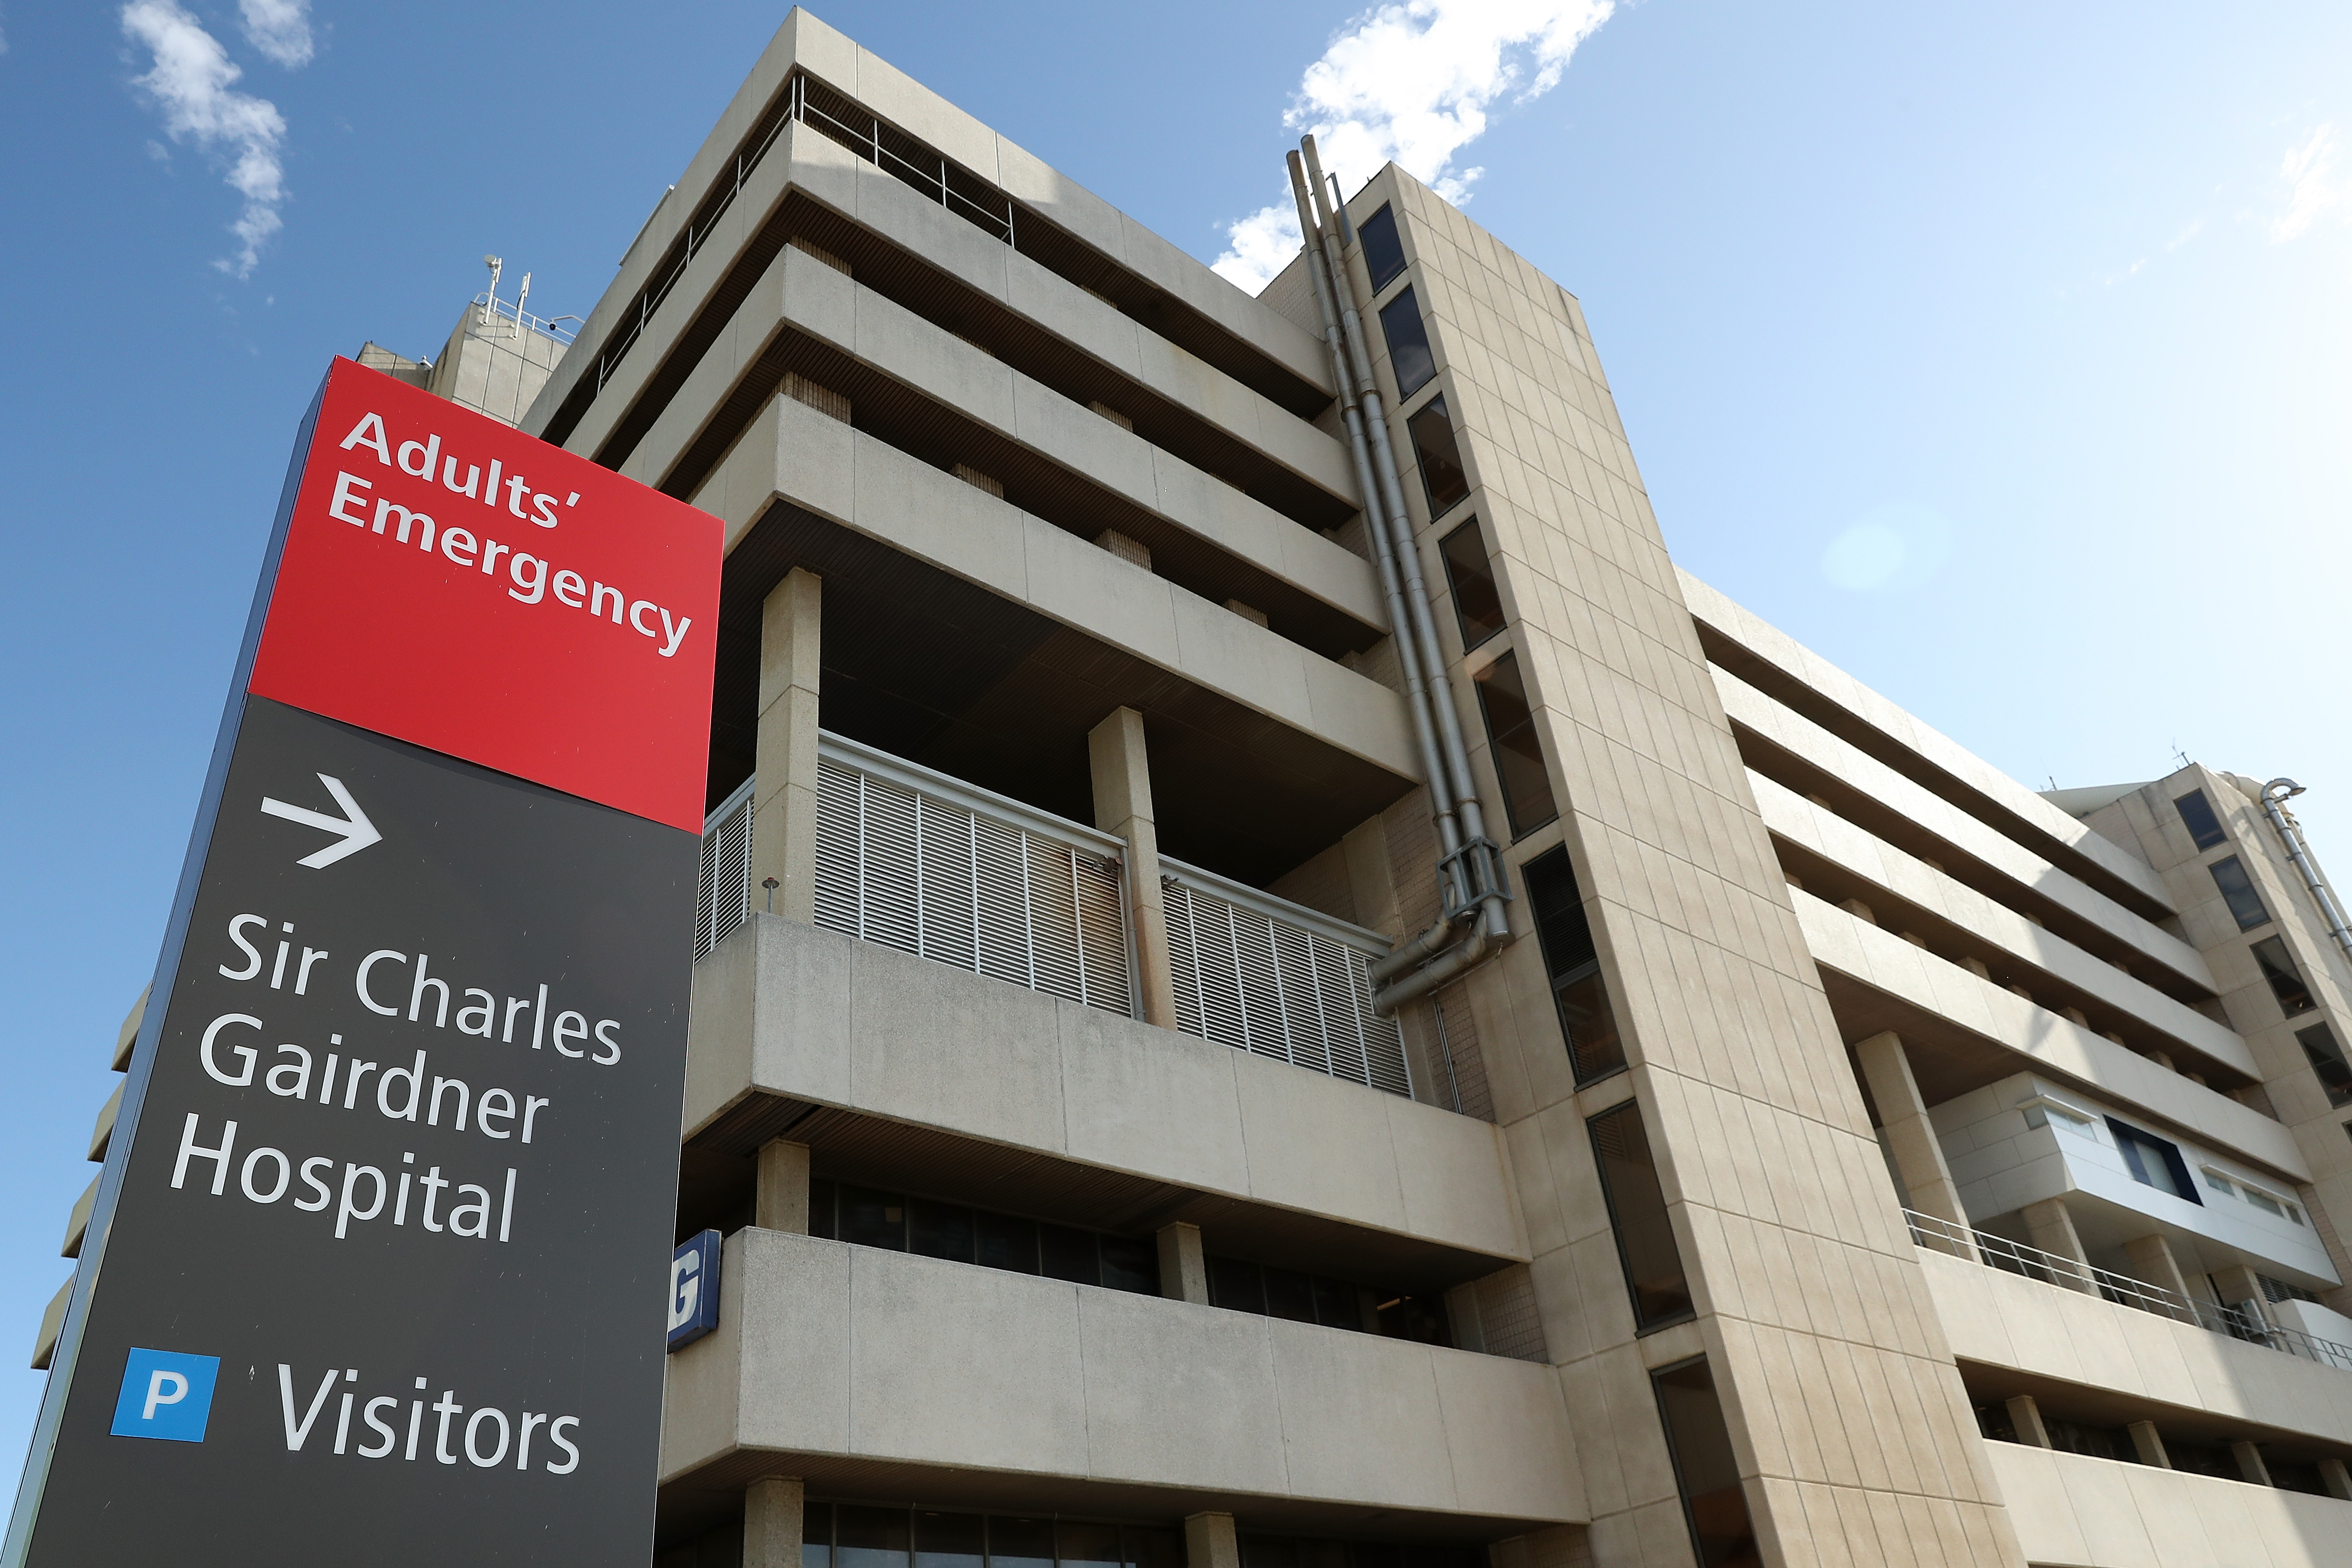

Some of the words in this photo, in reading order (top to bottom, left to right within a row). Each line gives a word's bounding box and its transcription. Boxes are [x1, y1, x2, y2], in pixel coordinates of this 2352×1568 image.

[329, 470, 692, 657] Emergency
[219, 914, 329, 995] Sir
[356, 950, 621, 1065] Charles
[200, 1013, 549, 1144] Gairdner
[170, 1112, 517, 1243] Hospital
[668, 1249, 700, 1333] G
[142, 1370, 188, 1420] P
[278, 1363, 580, 1474] Visitors
